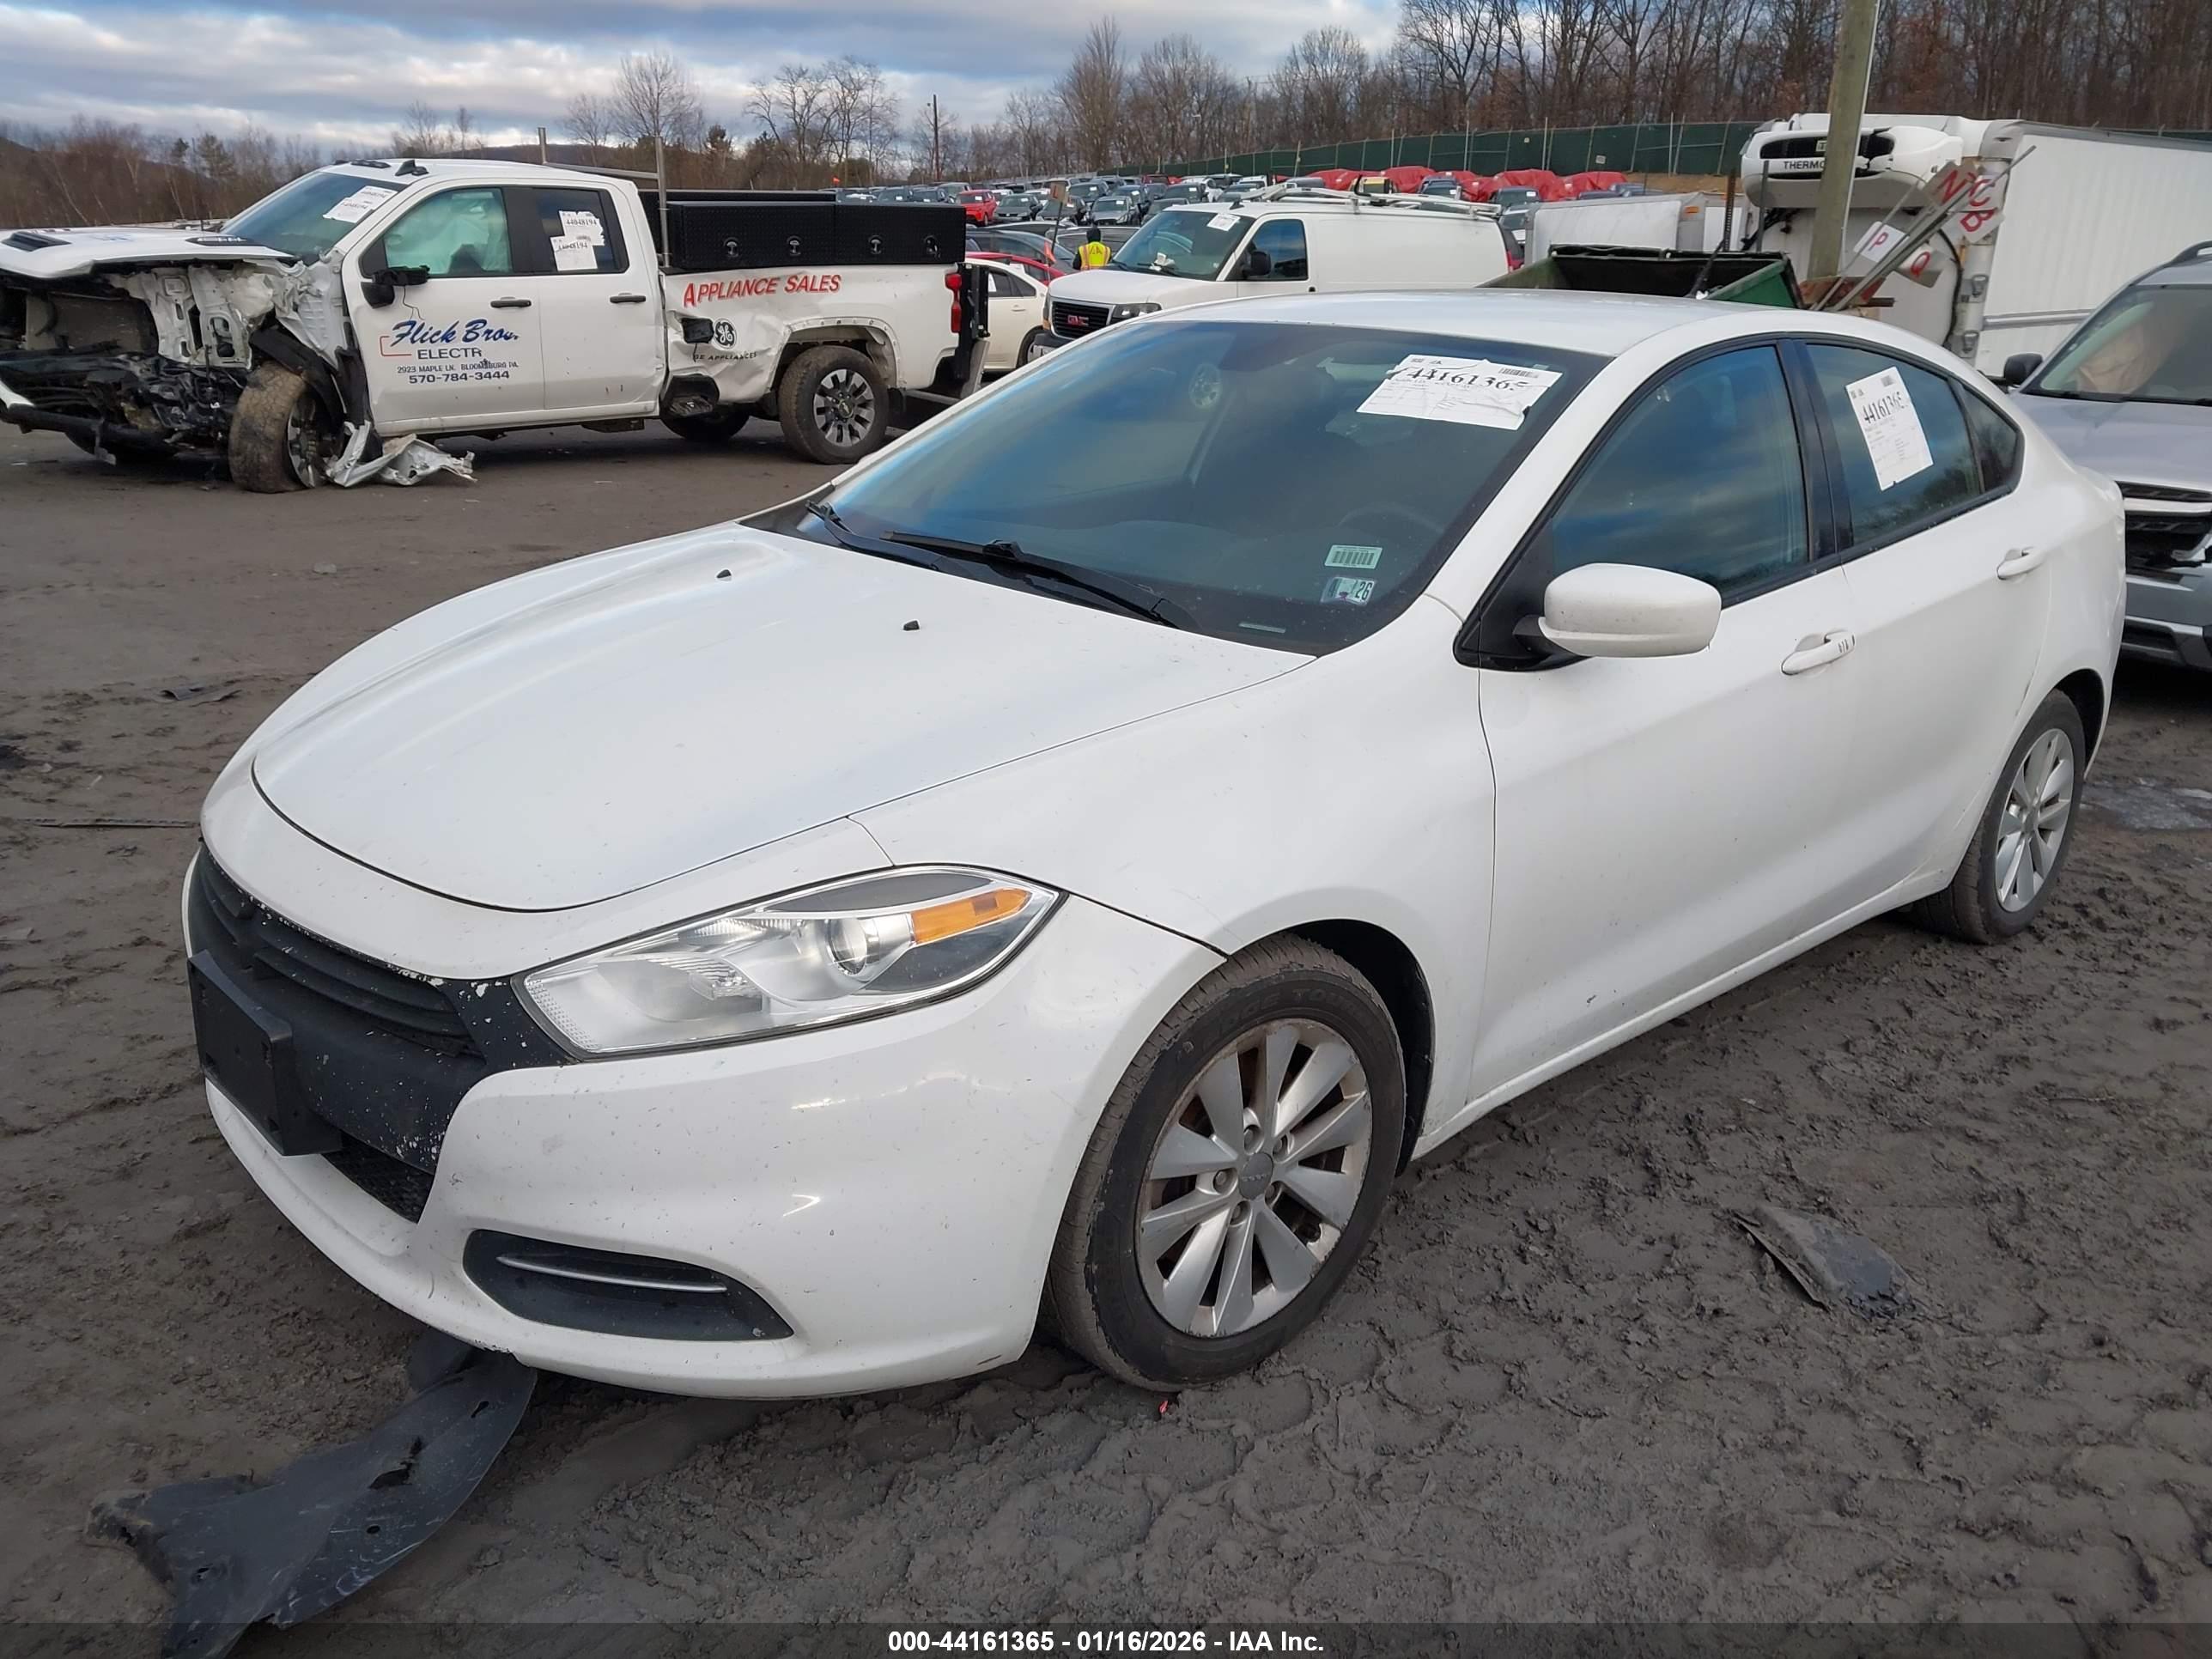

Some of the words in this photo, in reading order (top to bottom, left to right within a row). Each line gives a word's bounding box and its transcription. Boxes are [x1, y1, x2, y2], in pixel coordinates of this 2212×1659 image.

[684, 277, 780, 307] APPLIANCE
[785, 274, 842, 294] SALES
[1067, 314, 1090, 326] GMC
[391, 319, 459, 347] Flick
[417, 347, 483, 360] ELECTR
[418, 364, 443, 373] MAPLE
[409, 370, 510, 384] 570-784-3444
[1355, 580, 1373, 600] 26
